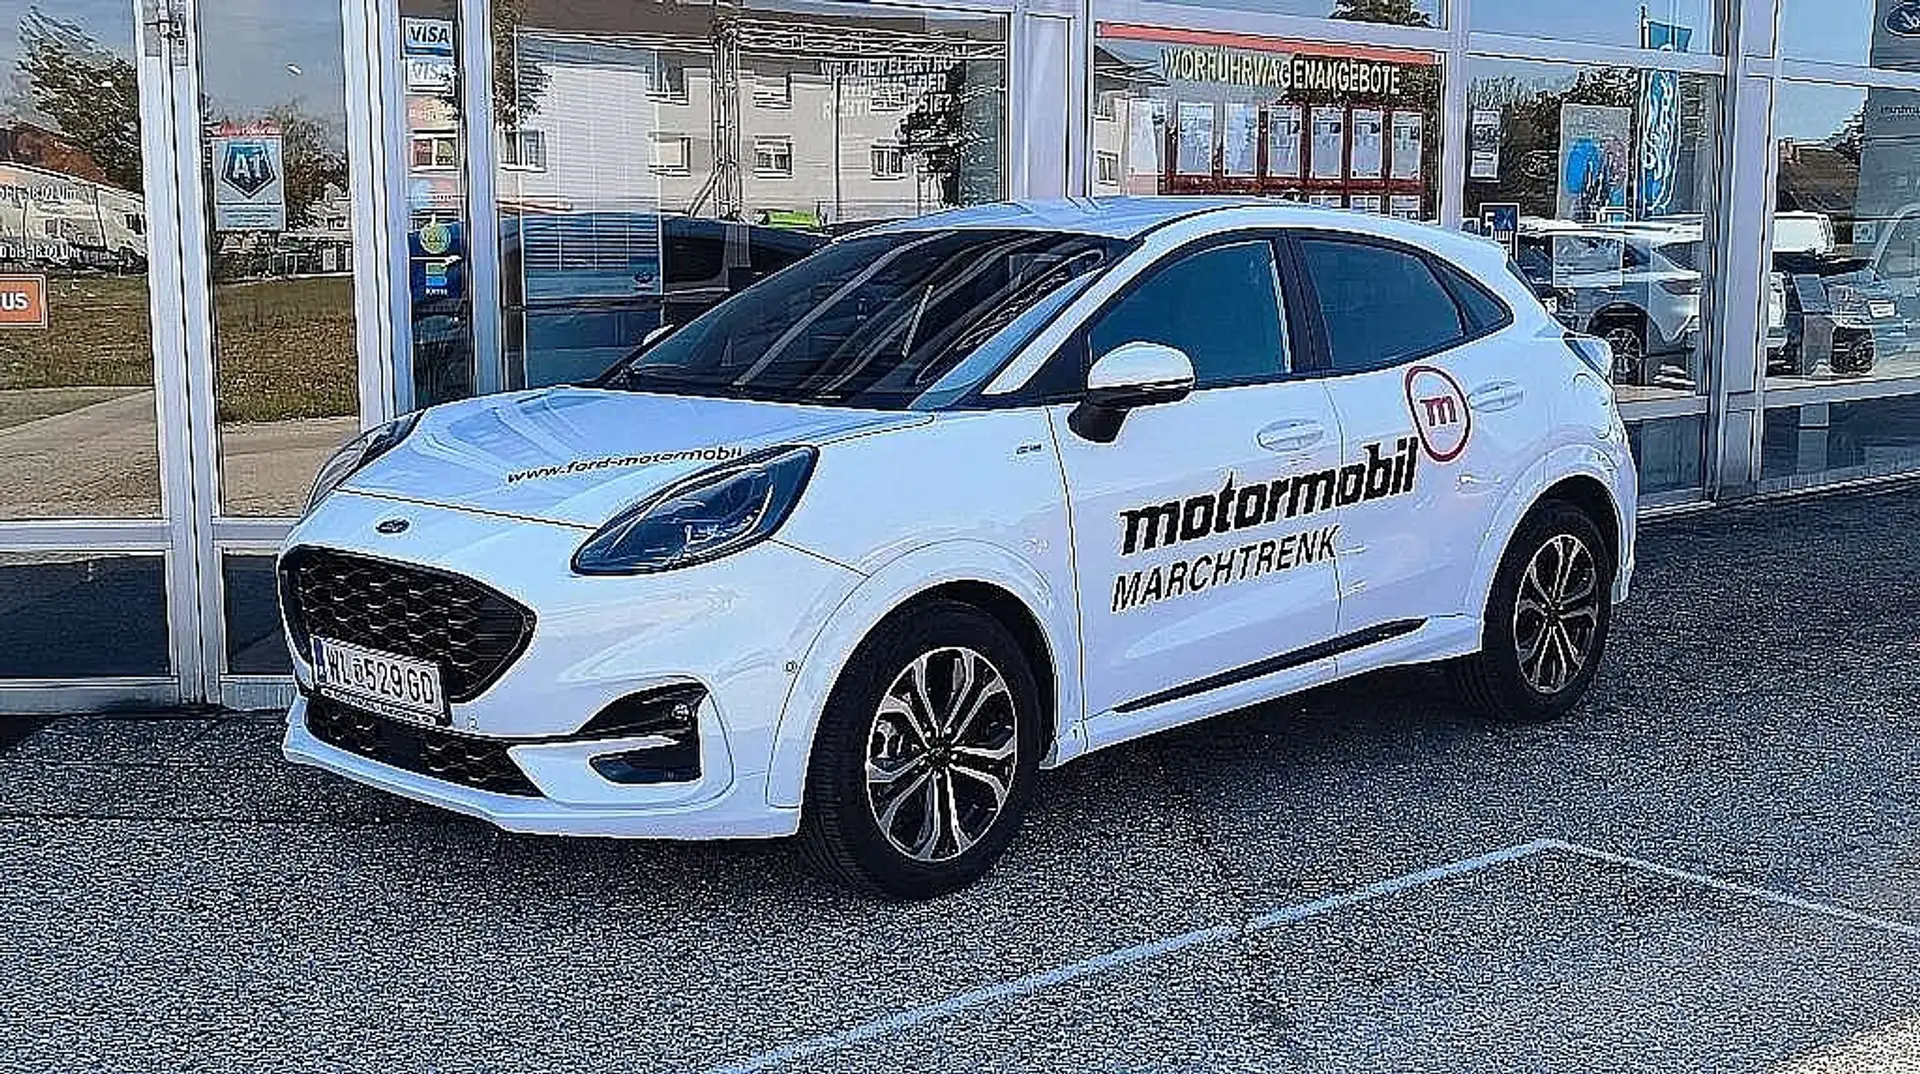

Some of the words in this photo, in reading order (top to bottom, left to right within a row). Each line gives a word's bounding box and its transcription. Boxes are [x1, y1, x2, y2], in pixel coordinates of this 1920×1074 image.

[409, 26, 450, 44] VISA
[1118, 436, 1419, 557] motormobil
[1110, 524, 1341, 613] MARCHTRENK
